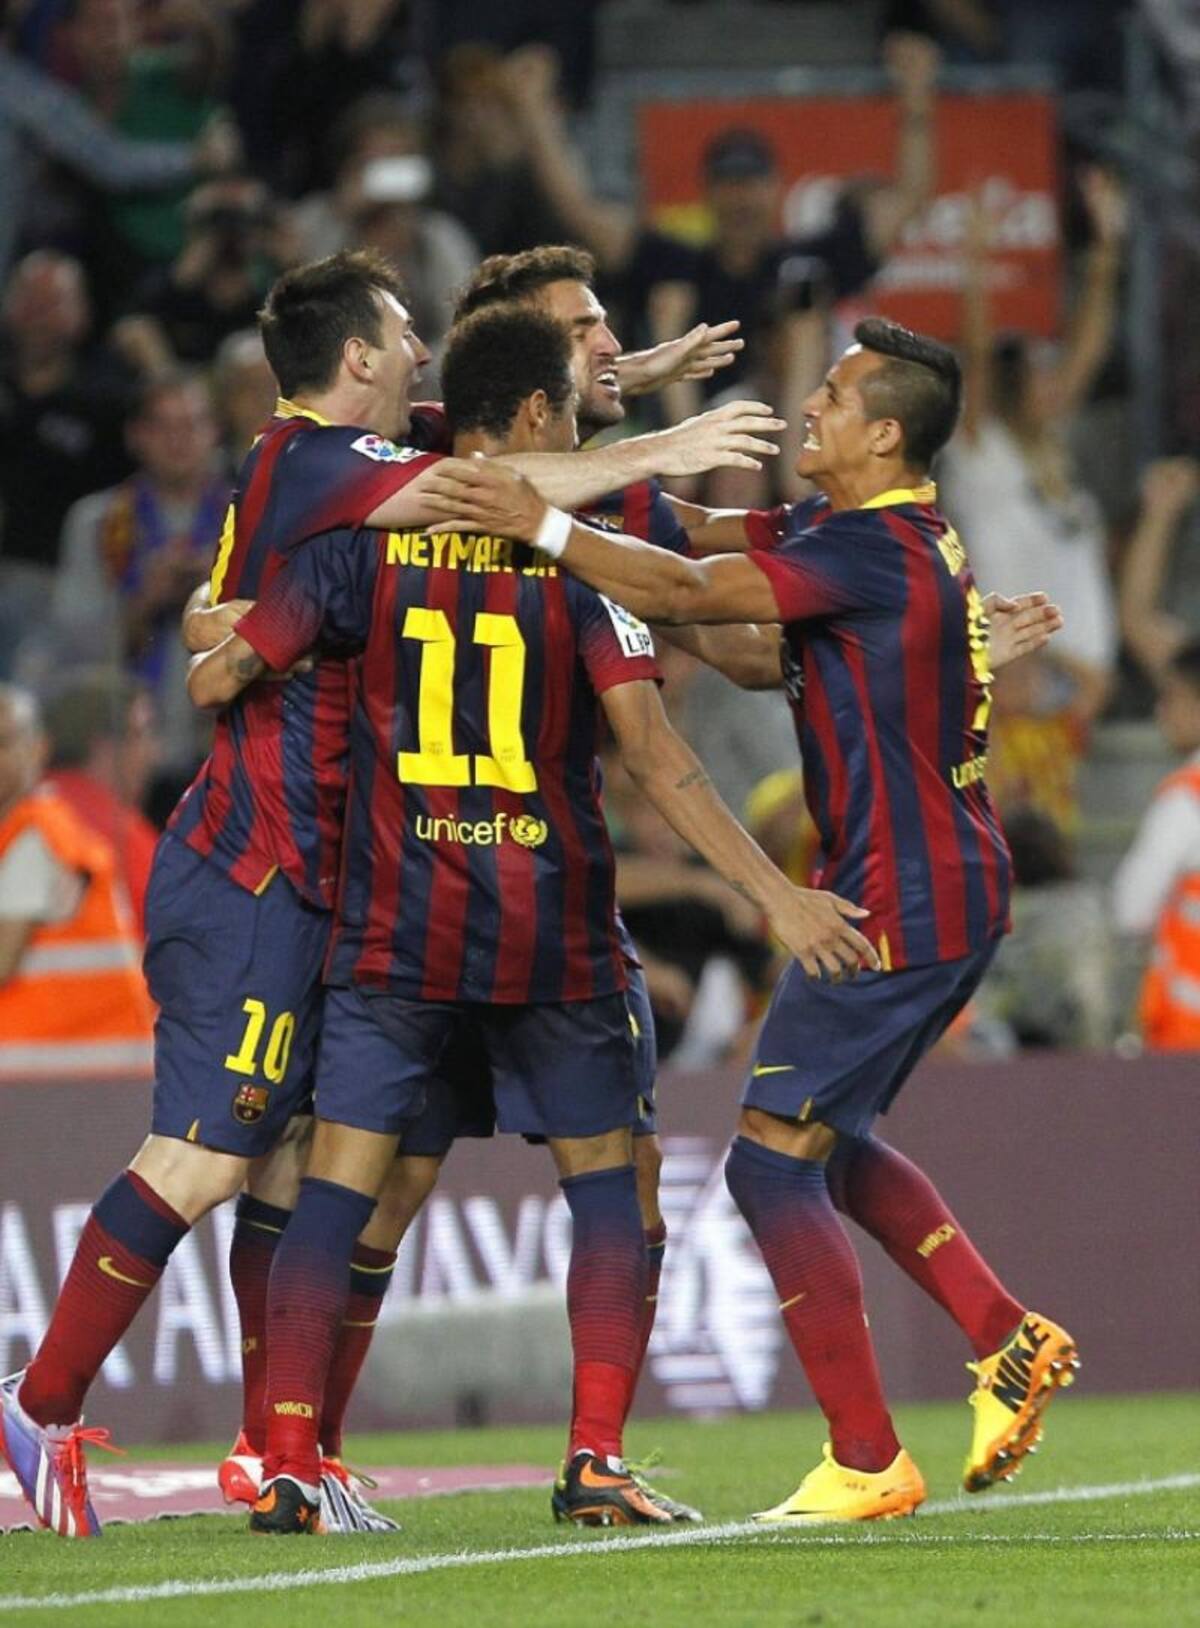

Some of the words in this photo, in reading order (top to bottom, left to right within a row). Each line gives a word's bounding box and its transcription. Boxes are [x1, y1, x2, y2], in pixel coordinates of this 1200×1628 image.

[398, 607, 538, 793] 11
[415, 813, 508, 845] unicef
[225, 998, 295, 1084] 10
[992, 1322, 1050, 1415] NIKE
